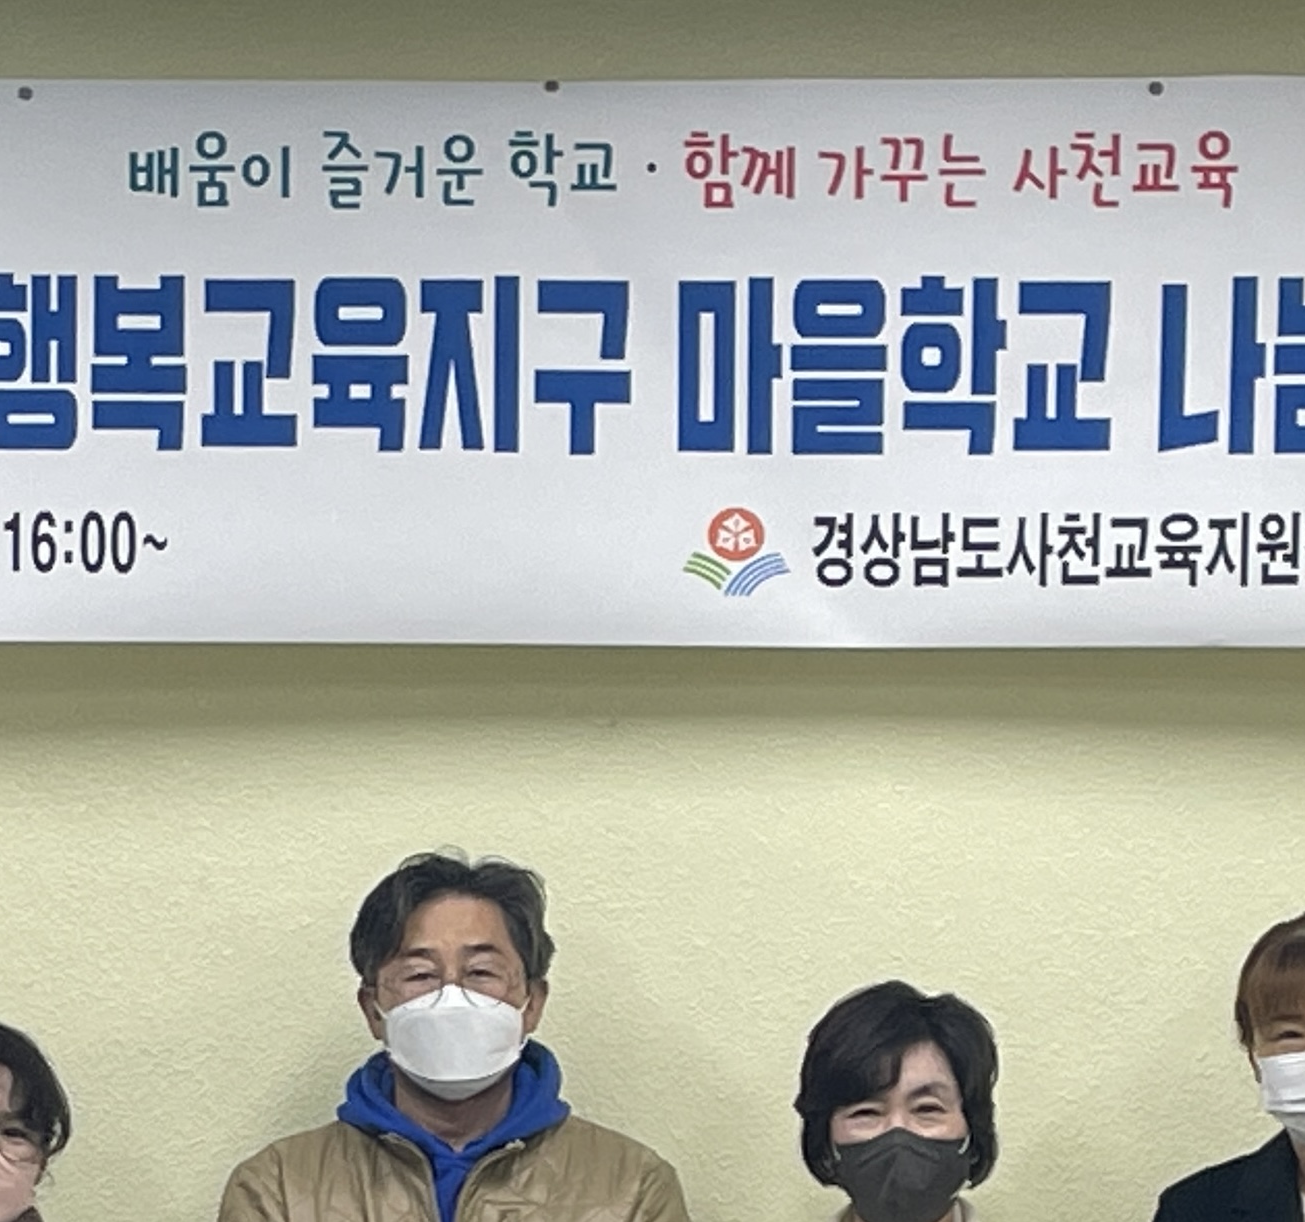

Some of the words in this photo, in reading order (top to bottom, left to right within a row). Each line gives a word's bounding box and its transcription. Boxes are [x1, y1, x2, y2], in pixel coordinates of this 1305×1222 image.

[127, 129, 292, 209] 배움이
[320, 129, 485, 211] 즐거운
[507, 129, 618, 208] 학교
[682, 130, 797, 210] 함께
[817, 132, 987, 209] 가꾸는
[1012, 129, 1240, 209] 사천교육
[677, 275, 1109, 454] 마을학교
[3, 510, 169, 575] 16:00~
